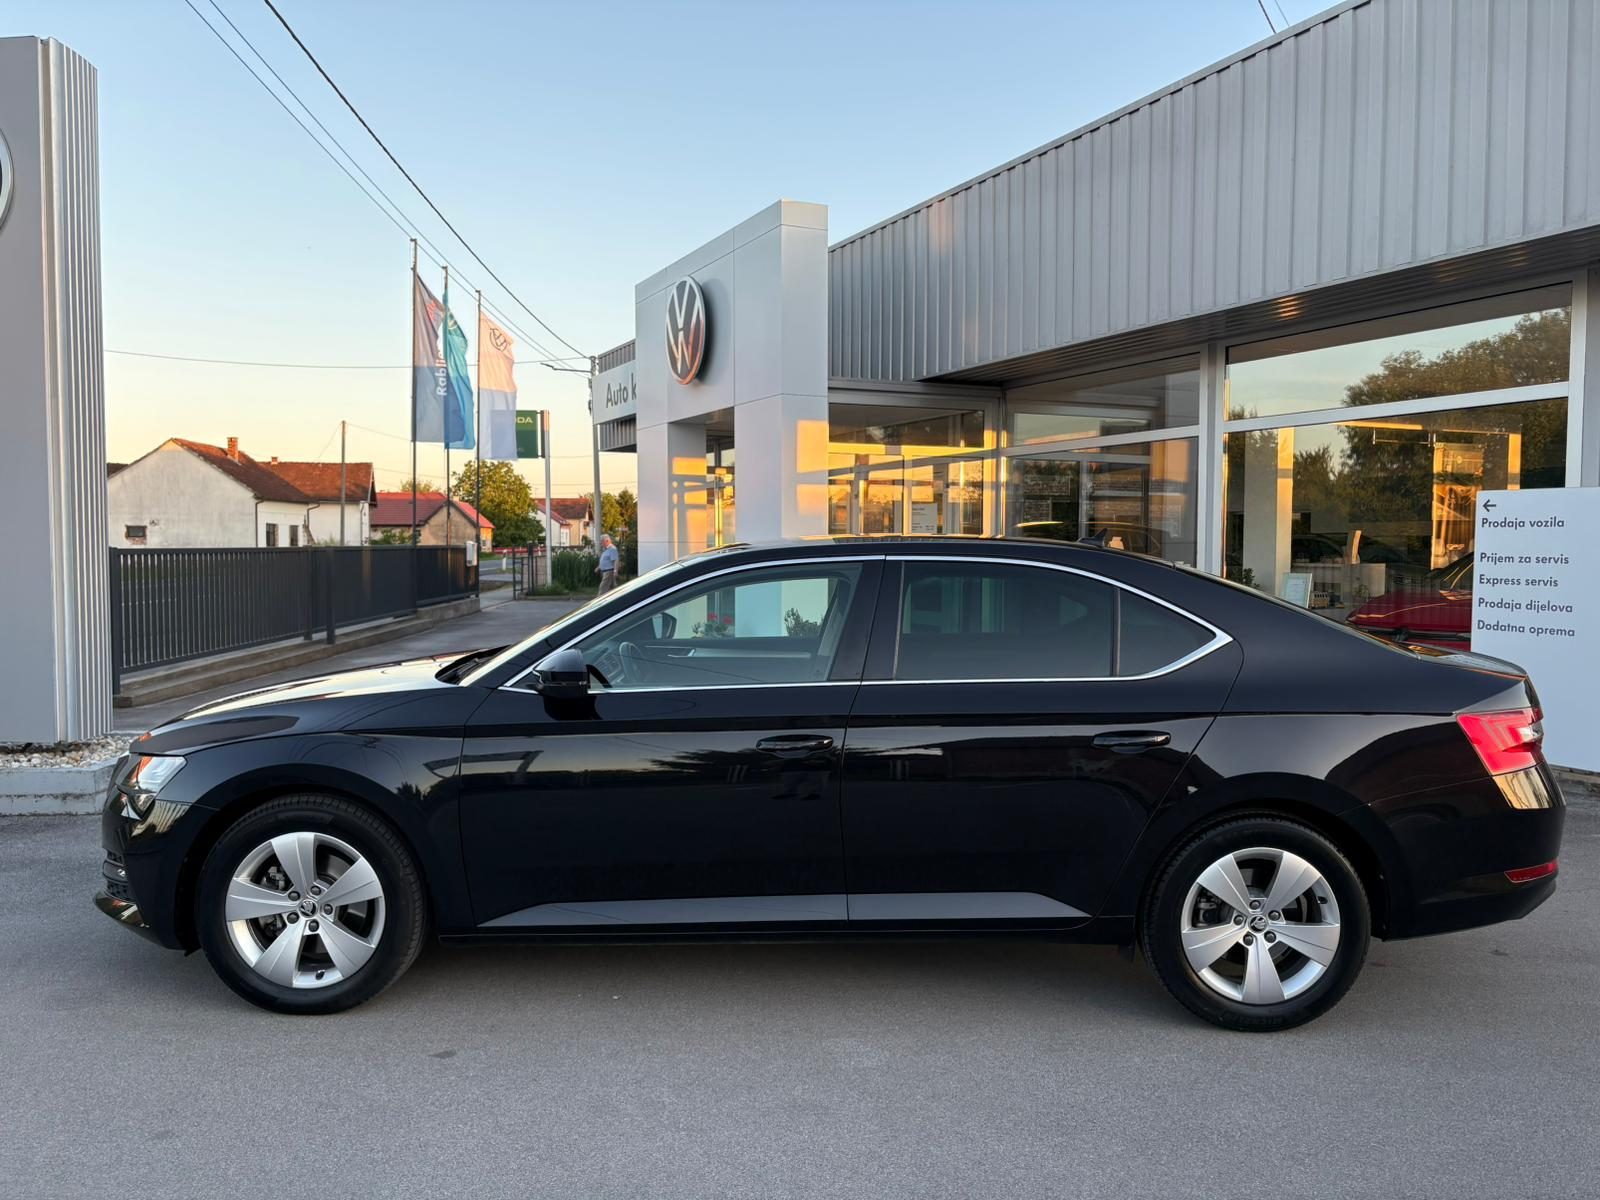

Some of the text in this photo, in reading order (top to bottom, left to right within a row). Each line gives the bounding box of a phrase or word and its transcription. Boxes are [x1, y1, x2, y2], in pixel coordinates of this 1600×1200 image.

[605, 383, 629, 409] Auto
[1481, 516, 1564, 530] Prodaja vozila
[1479, 552, 1569, 565] Prijem za servis
[1479, 574, 1558, 587] Express servis
[1478, 597, 1573, 613] Prodaja dijelova
[1477, 619, 1575, 637] Dodatna oprema
